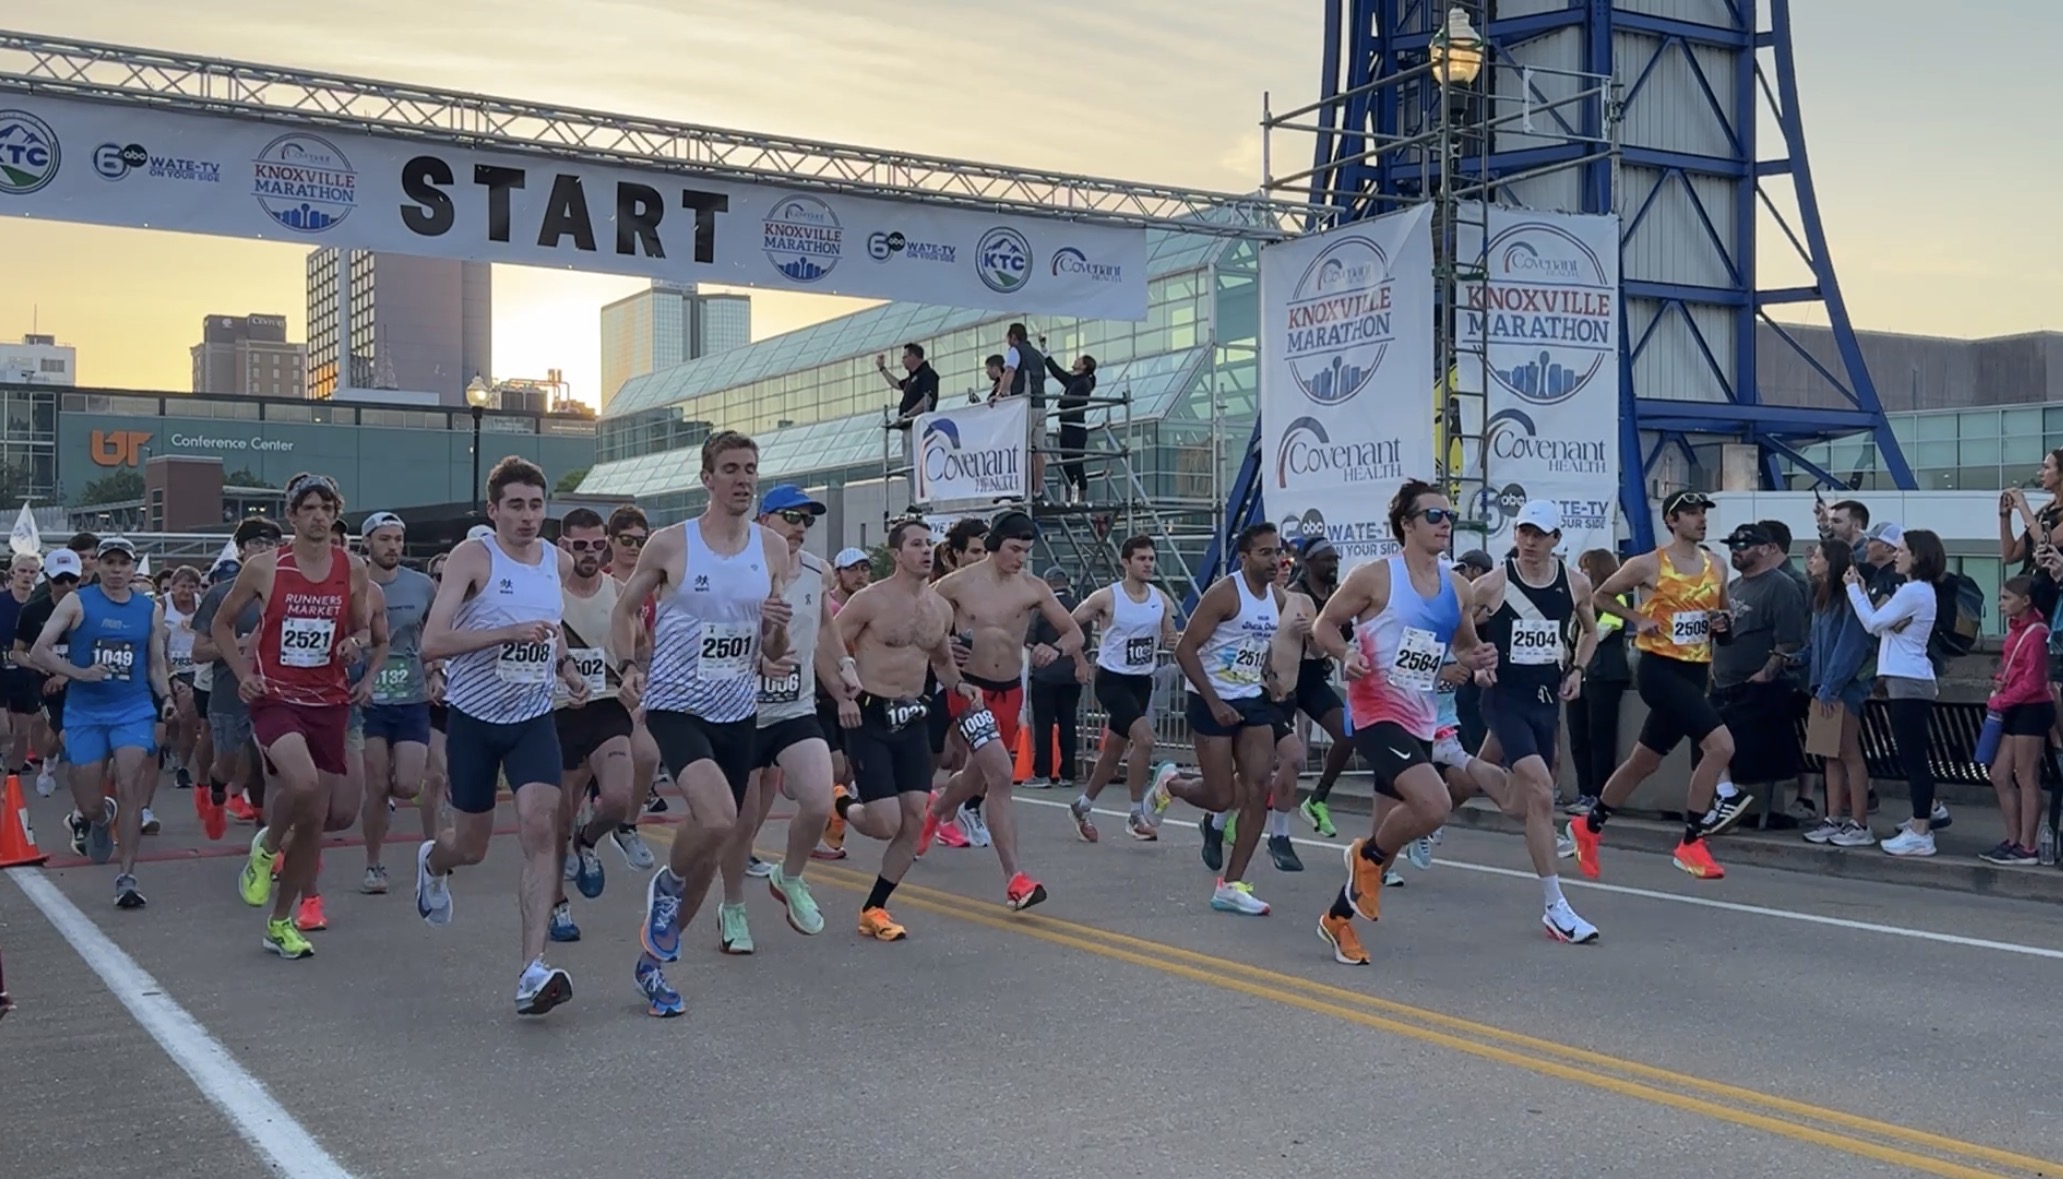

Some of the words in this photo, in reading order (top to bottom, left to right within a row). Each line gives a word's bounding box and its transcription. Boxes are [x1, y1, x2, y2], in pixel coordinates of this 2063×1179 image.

[0, 144, 48, 167] TC
[150, 156, 220, 173] WATE-TV
[150, 169, 165, 178] ON
[167, 169, 195, 180] YOUR
[197, 172, 220, 183] SIDE
[255, 163, 355, 189] KNOXVILLE
[254, 179, 354, 203] MARATHON
[400, 155, 729, 264] START
[764, 223, 842, 243] KNOXVILLE
[764, 237, 840, 255] MARATHON
[867, 232, 893, 260] 6
[906, 242, 956, 255] WATE-TV
[984, 252, 1025, 272] KTC
[1059, 256, 1121, 277] Covenant
[1512, 251, 1578, 271] Covenant
[1288, 287, 1391, 330] KNOXVILLE
[1466, 286, 1610, 317] KNOXVILLE
[1287, 312, 1391, 353] MARATHON
[1467, 312, 1609, 344] MARATHON
[91, 430, 153, 467] UT
[171, 433, 247, 450] Conference
[250, 437, 294, 452] Center
[1494, 429, 1606, 462] Covenant
[925, 446, 1019, 482] Covenant
[1289, 437, 1401, 475] Covenant
[1343, 463, 1402, 483] HEALTH
[1549, 459, 1607, 474] HEALTH
[974, 474, 1019, 494] HEALTH
[1501, 493, 1525, 507] abc
[1552, 500, 1609, 516] TE-TV
[1302, 519, 1324, 535] abc
[1327, 520, 1395, 540] WATE-T
[1585, 519, 1606, 529] SIDE
[1346, 543, 1378, 556] YOUR
[1380, 541, 1400, 555] SID
[285, 594, 342, 604] RUNNERS
[287, 604, 341, 616] MARKET
[1675, 620, 1708, 637] 2509
[284, 630, 331, 649] 2521
[702, 636, 751, 658] 2501
[1514, 631, 1556, 647] 2504
[93, 649, 133, 666] 1049
[501, 642, 550, 663] 2508
[1395, 649, 1440, 673] 2564
[376, 670, 408, 684] 132
[960, 710, 995, 738] 1008
